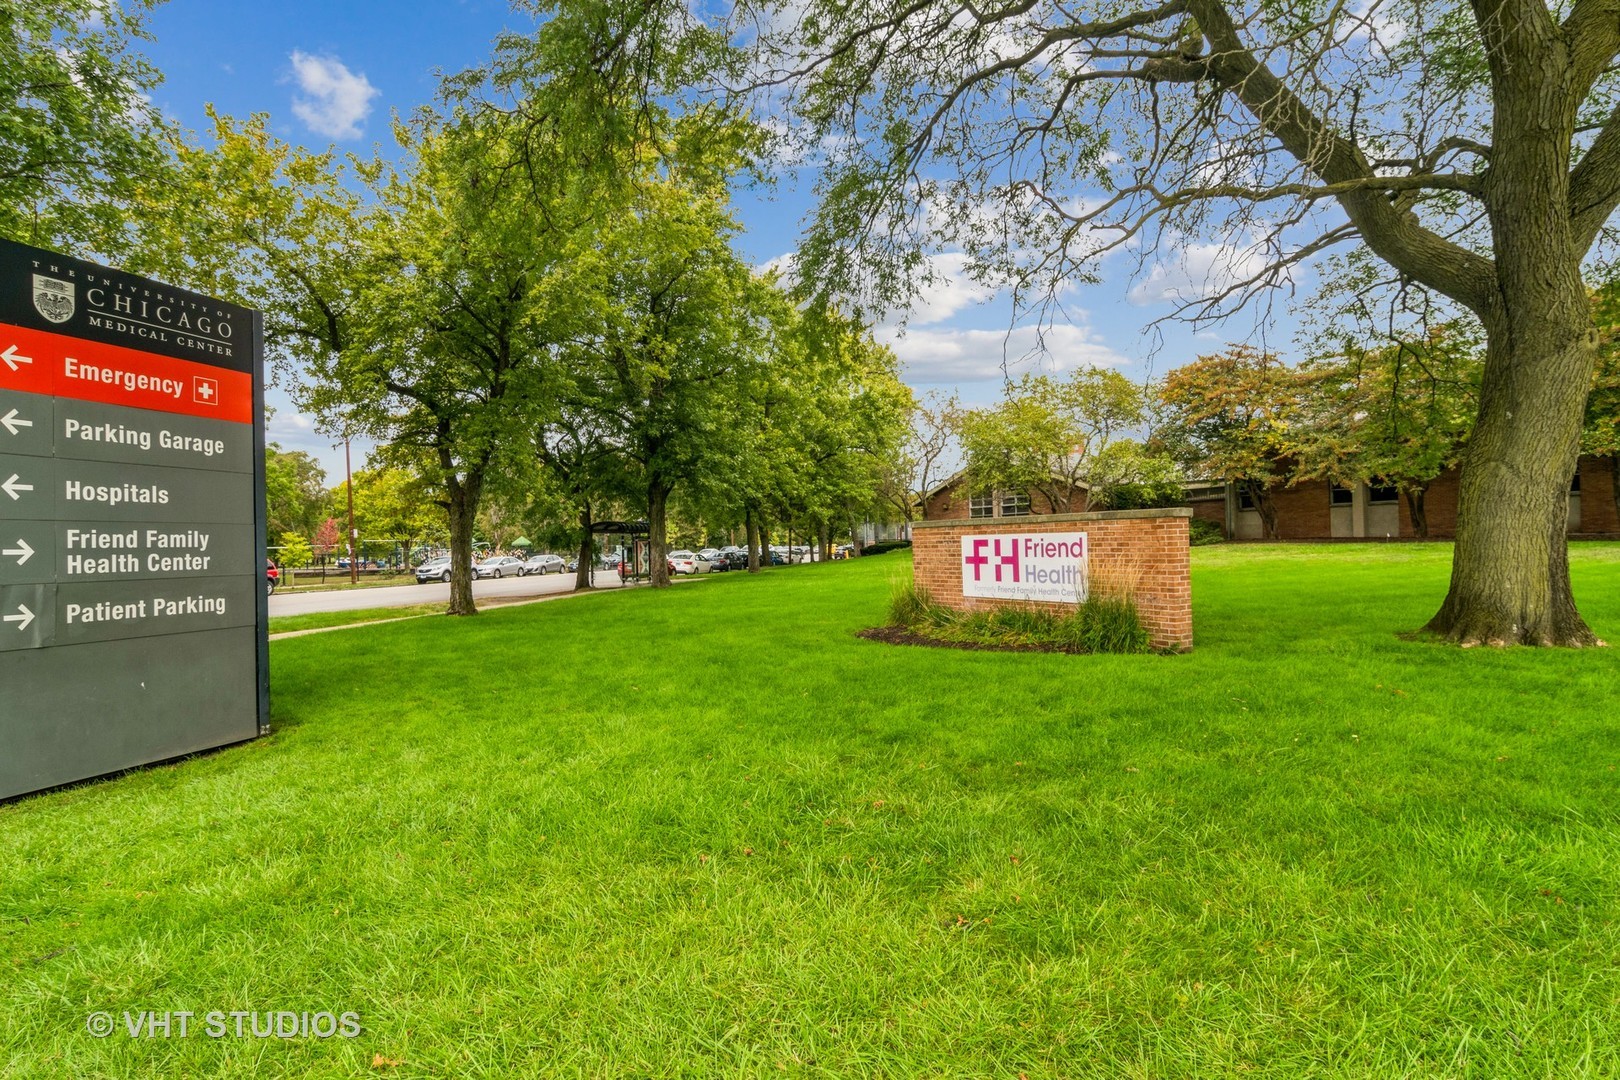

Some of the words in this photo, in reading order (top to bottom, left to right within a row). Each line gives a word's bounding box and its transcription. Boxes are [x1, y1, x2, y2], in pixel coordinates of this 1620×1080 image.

[32, 260, 76, 277] THE
[87, 274, 208, 313] UNIVERSITY
[216, 310, 231, 319] OF
[87, 288, 232, 339] CHICAGO
[89, 315, 168, 342] MEDICAL
[176, 336, 233, 357] CENTER
[65, 357, 183, 398] Emergency
[65, 418, 151, 450] Parking
[159, 430, 225, 456] Garage
[65, 480, 169, 506] Hospitals
[66, 529, 138, 549] Friend
[146, 530, 210, 552] Family
[1025, 537, 1083, 558] Friend
[66, 554, 140, 575] Health
[147, 553, 211, 572] Center
[1025, 564, 1084, 584] Health
[997, 585, 1016, 594] Friend
[1016, 586, 1037, 596] Family
[1037, 587, 1060, 596] Health
[66, 600, 146, 624] Patient
[153, 596, 226, 617] Parking
